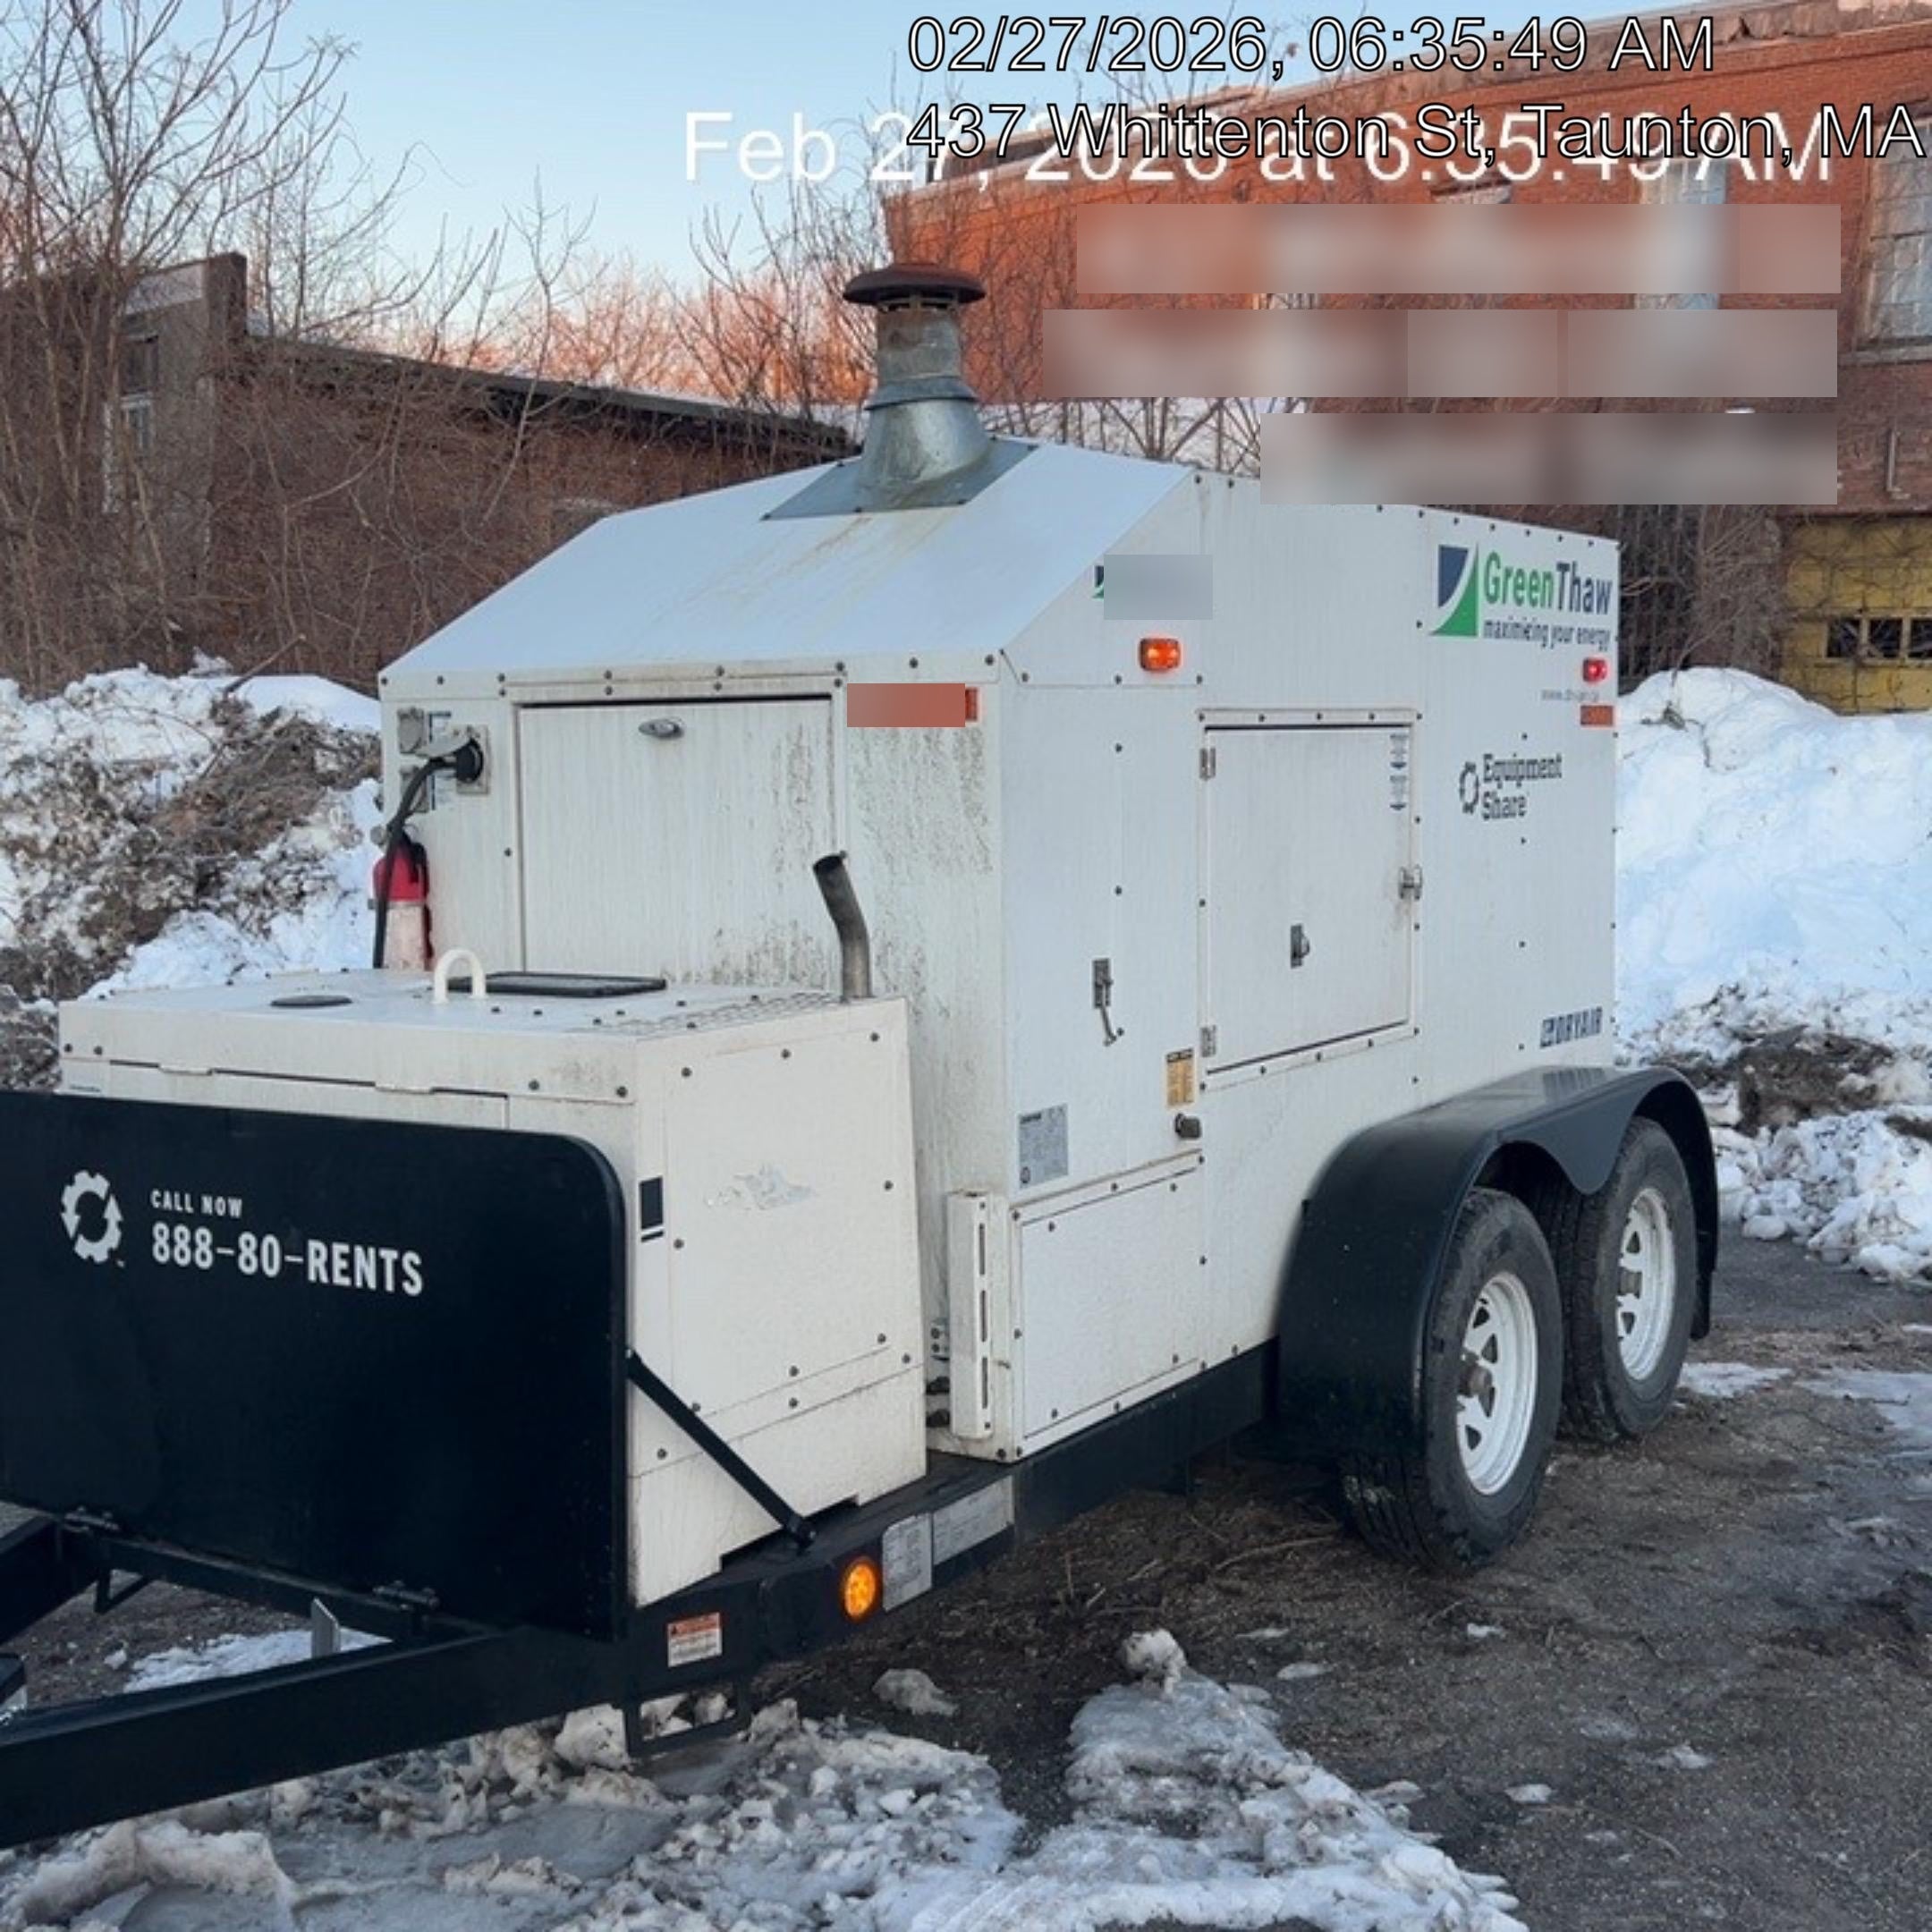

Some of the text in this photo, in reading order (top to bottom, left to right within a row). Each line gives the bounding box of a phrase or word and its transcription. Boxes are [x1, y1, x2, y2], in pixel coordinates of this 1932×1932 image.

[1485, 551, 1614, 615] GreenThaw
[150, 1189, 243, 1219] CALL NOW
[151, 1222, 424, 1297] 888-80-RENTS
